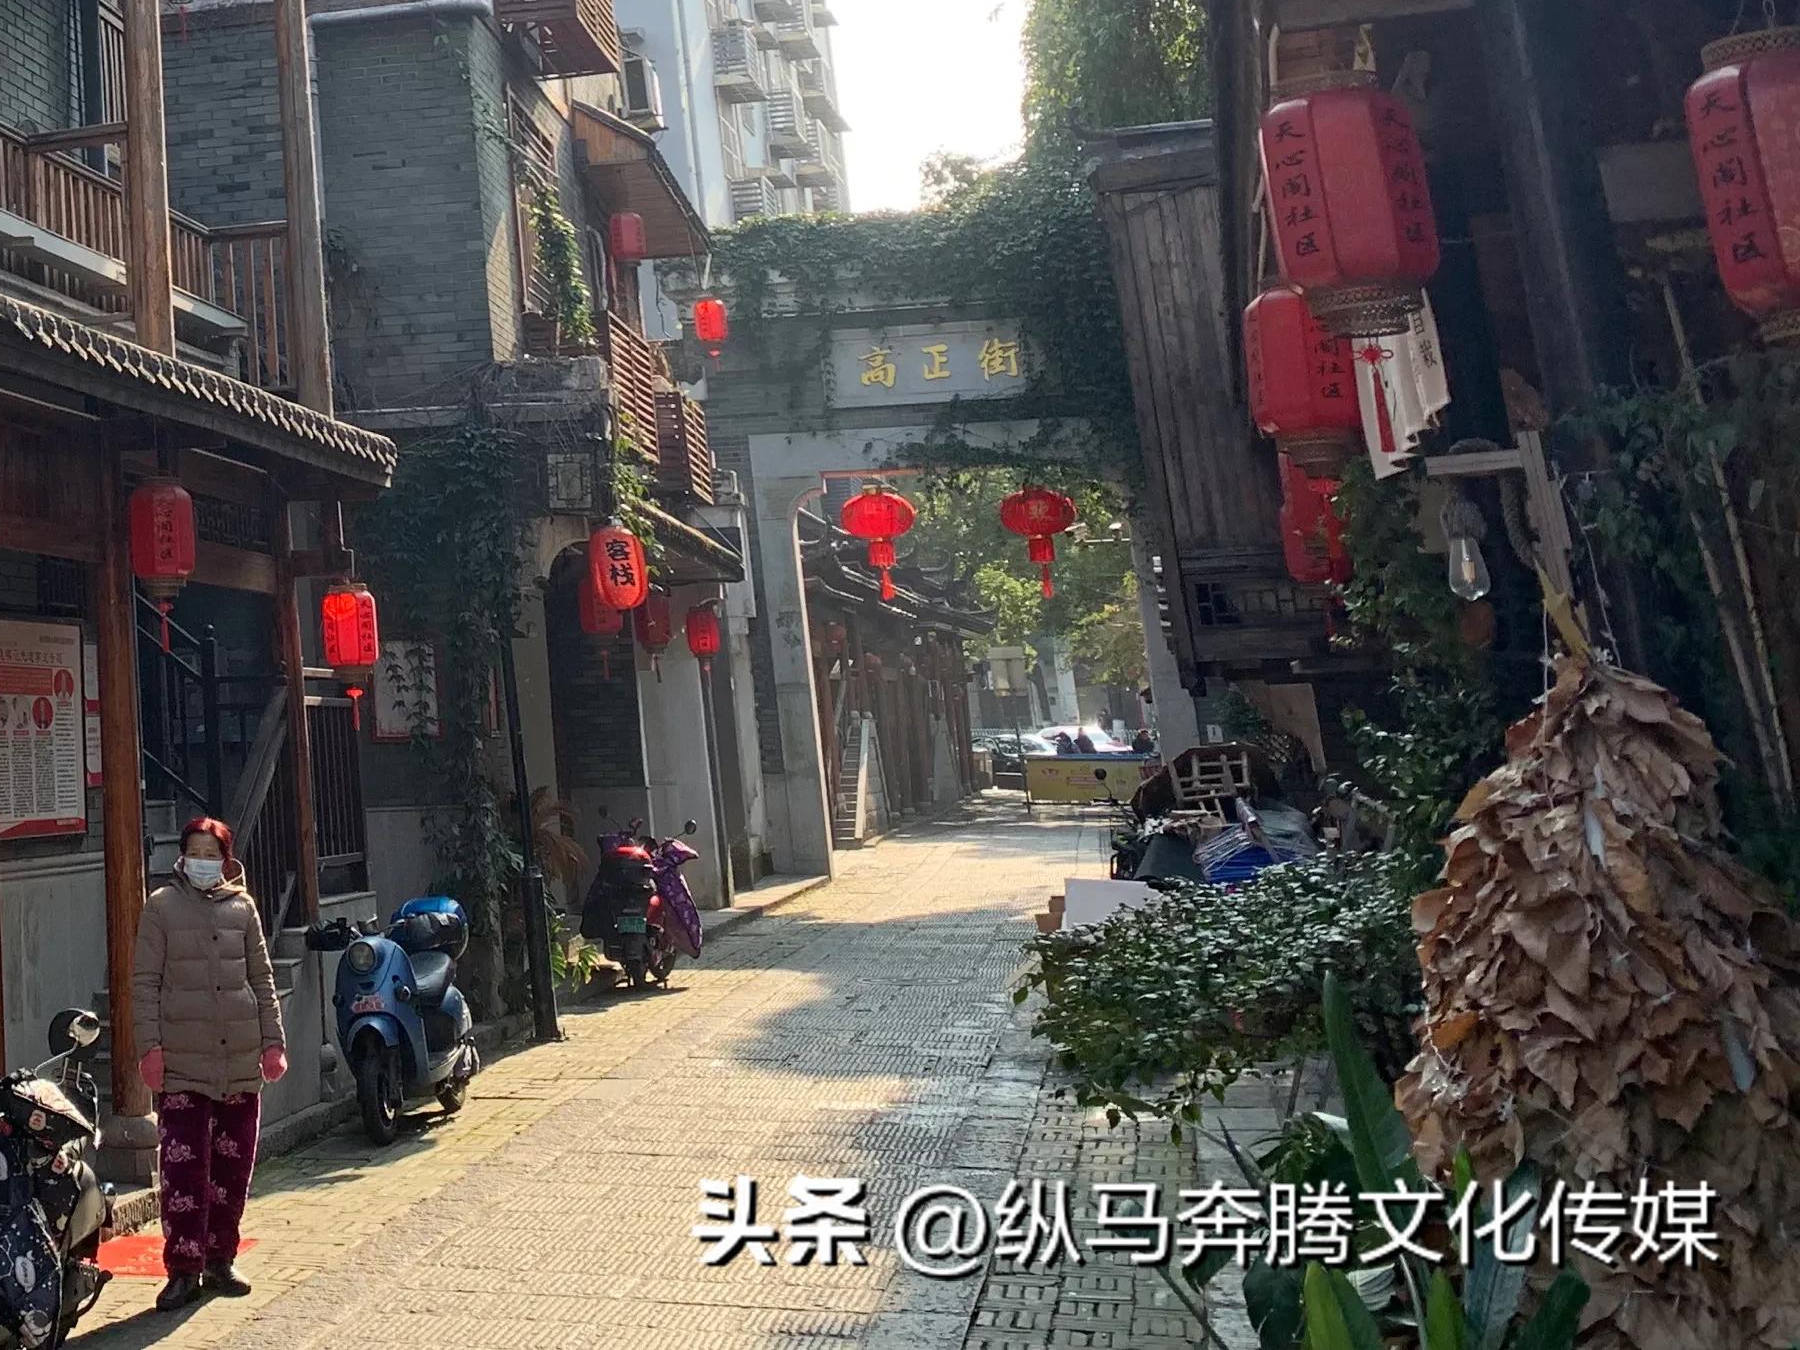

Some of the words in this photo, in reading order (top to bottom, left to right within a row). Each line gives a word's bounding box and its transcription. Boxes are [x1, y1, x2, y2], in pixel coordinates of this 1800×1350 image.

[1274, 121, 1321, 257] 天心阁社区
[1700, 90, 1767, 264] 天心阁社区
[857, 337, 1021, 388] 高正街
[605, 538, 636, 587] 客栈
